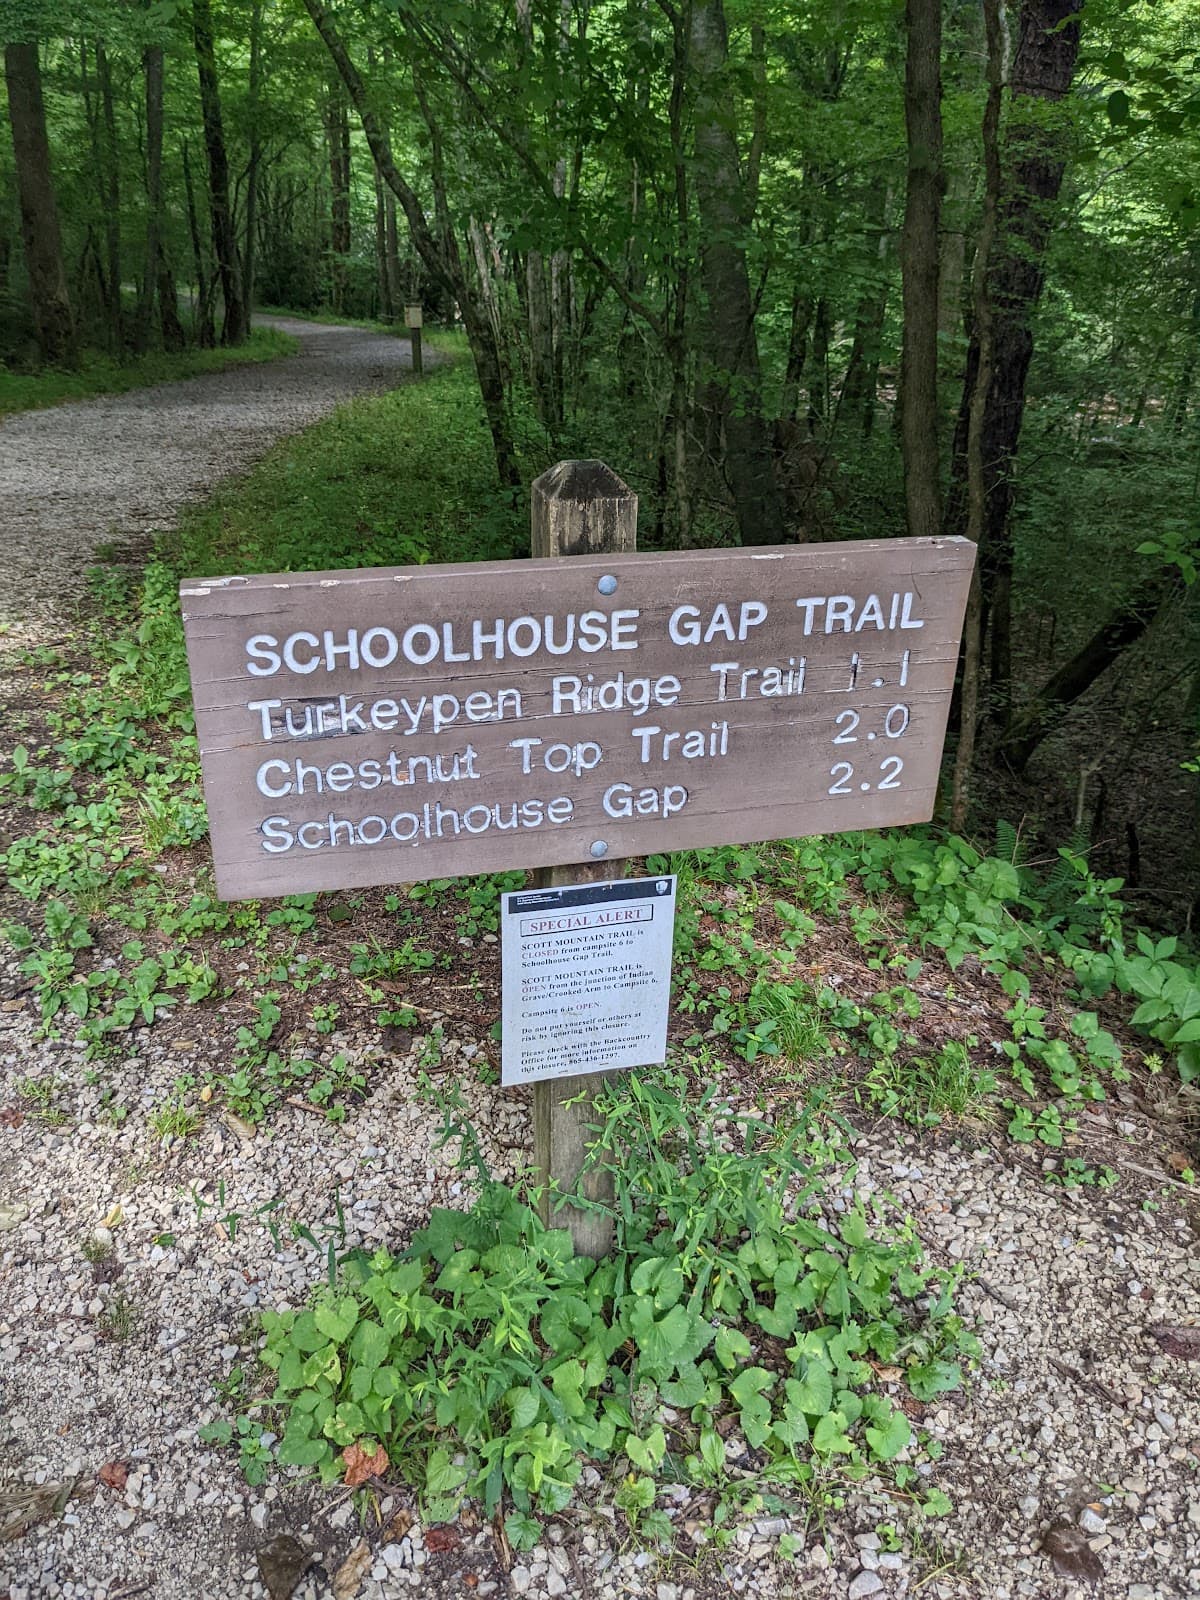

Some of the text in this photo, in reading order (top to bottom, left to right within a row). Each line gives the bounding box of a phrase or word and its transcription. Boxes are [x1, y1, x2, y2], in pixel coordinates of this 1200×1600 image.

[245, 592, 925, 677] SCHOOLHOUSE GAP TRAIL
[248, 648, 911, 740] Turkeypen Ridge Trail 1.1
[256, 703, 910, 798] Chestnut Top Trail 2.0
[260, 755, 905, 853] Schoolhouse Gap 2.2
[530, 909, 643, 932] SPECIAL ALERT
[522, 941, 552, 951] SCOTT
[555, 934, 605, 947] MOUNTAIN
[608, 931, 635, 939] TRAIL
[522, 950, 558, 959] CLOSED
[583, 942, 616, 952] campsite
[522, 956, 570, 968] Schoolhouse
[591, 950, 613, 958] Trail.
[522, 975, 552, 985] SCOTT
[555, 968, 604, 982] MOUNTAIN
[607, 965, 634, 973] TRAIL
[522, 984, 546, 993] OPEN
[585, 975, 616, 987] junction
[629, 970, 653, 978] Indian
[522, 988, 582, 1001] Grave/Crooked
[585, 985, 601, 993] Arm
[613, 980, 649, 990] Campsite
[522, 1009, 558, 1018] Campsite
[576, 1002, 602, 1011] OPEN.
[522, 1034, 536, 1042] risk
[551, 1027, 583, 1038] ignoring
[601, 1022, 630, 1030] closure.
[549, 1023, 563, 1032] put
[565, 1018, 596, 1028] yourself
[608, 1013, 632, 1022] others
[521, 1056, 544, 1065] Office
[582, 1043, 626, 1055] information
[522, 1049, 545, 1058] Please
[547, 1045, 568, 1053] check
[604, 1034, 651, 1044] Backcountry
[522, 1065, 535, 1073] this
[538, 1061, 567, 1071] closure,
